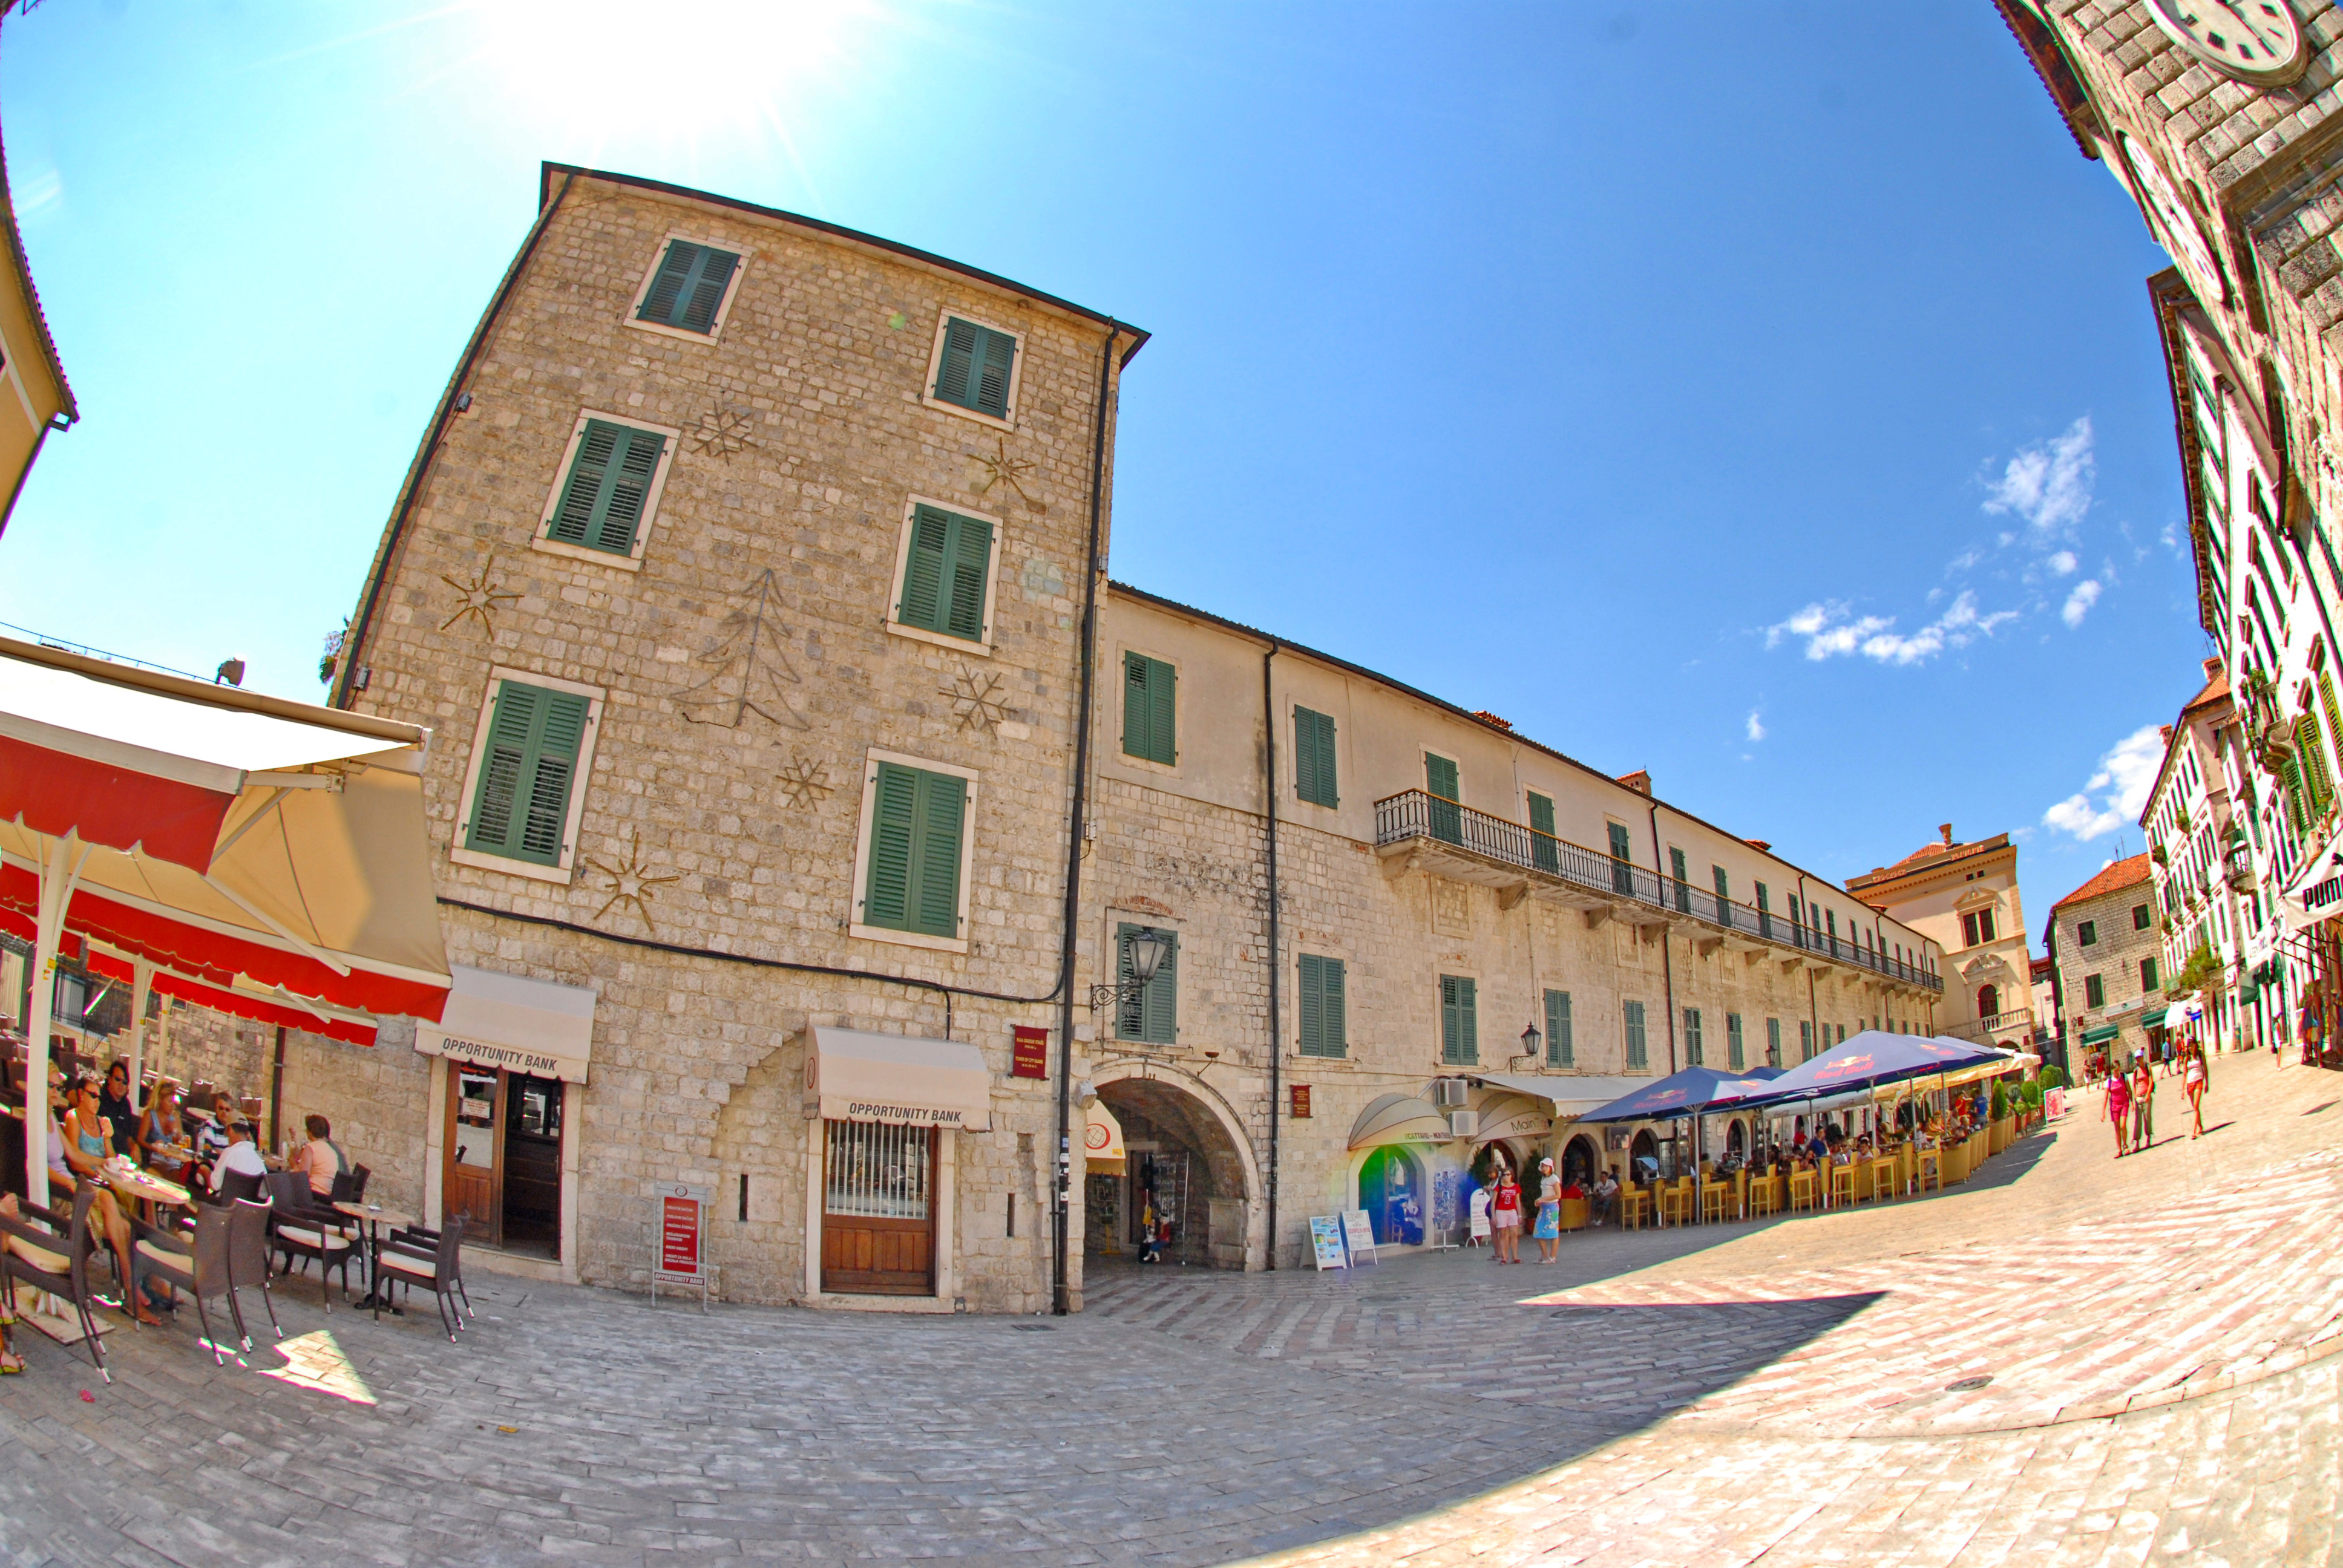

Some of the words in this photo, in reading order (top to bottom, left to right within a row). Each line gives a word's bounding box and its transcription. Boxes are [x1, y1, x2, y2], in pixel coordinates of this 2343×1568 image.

[2302, 874, 2343, 912] PUM
[443, 1038, 523, 1064] OPPORTUNITY
[525, 1054, 558, 1071] BANK
[1814, 1067, 1844, 1079] Red
[1844, 1061, 1874, 1075] Bull
[1633, 1100, 1660, 1109] Red
[1662, 1094, 1687, 1106] Bull
[849, 1102, 929, 1119] OPPORTUNITY
[931, 1109, 962, 1122] BANK
[1510, 1118, 1536, 1132] Main
[655, 1273, 689, 1283] OPPORTUNITY
